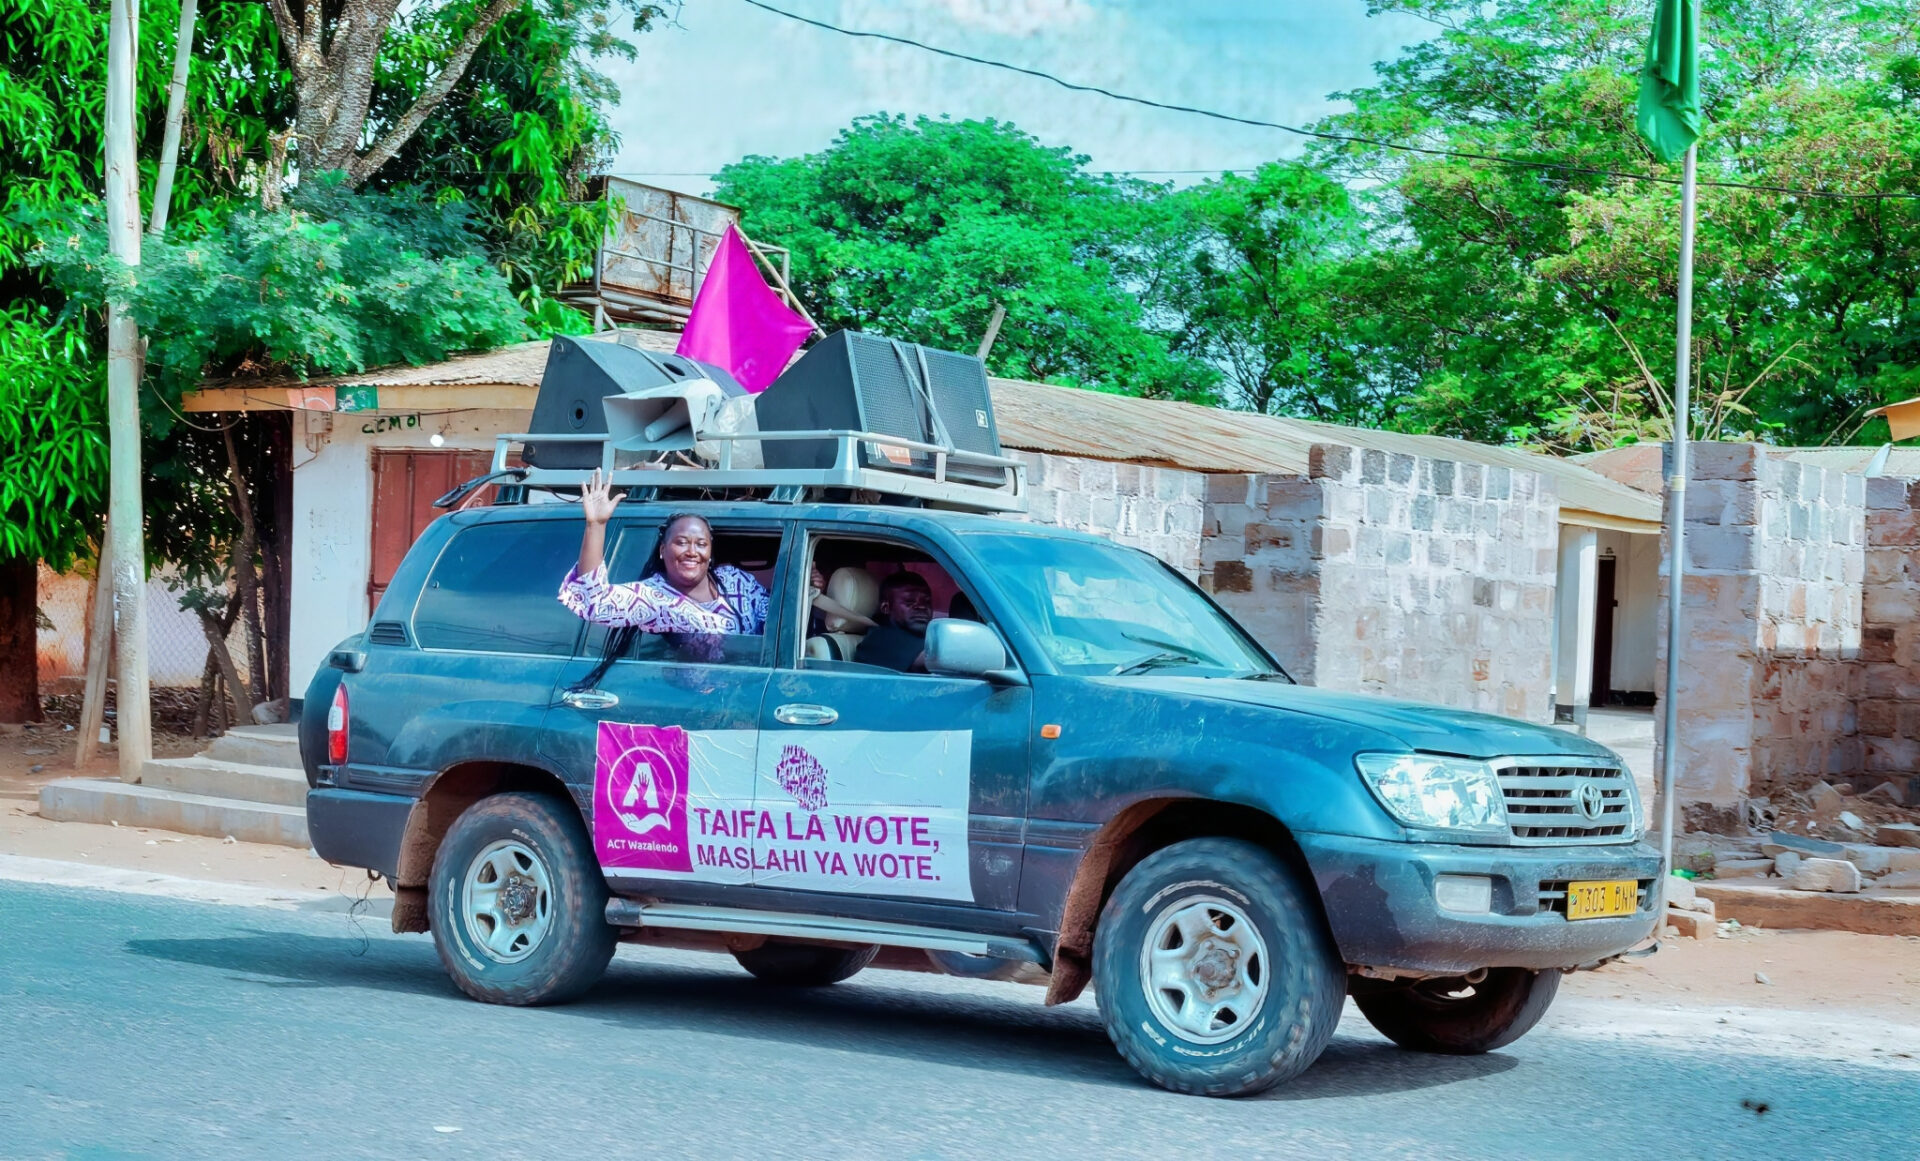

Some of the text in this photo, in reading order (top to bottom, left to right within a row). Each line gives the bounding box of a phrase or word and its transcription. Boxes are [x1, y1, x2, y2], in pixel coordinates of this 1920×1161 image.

[607, 839, 678, 853] ACT Wazalendo
[693, 807, 939, 853] TAIFA LA WOTE,
[696, 844, 941, 881] MASLAHI YA WOTE.
